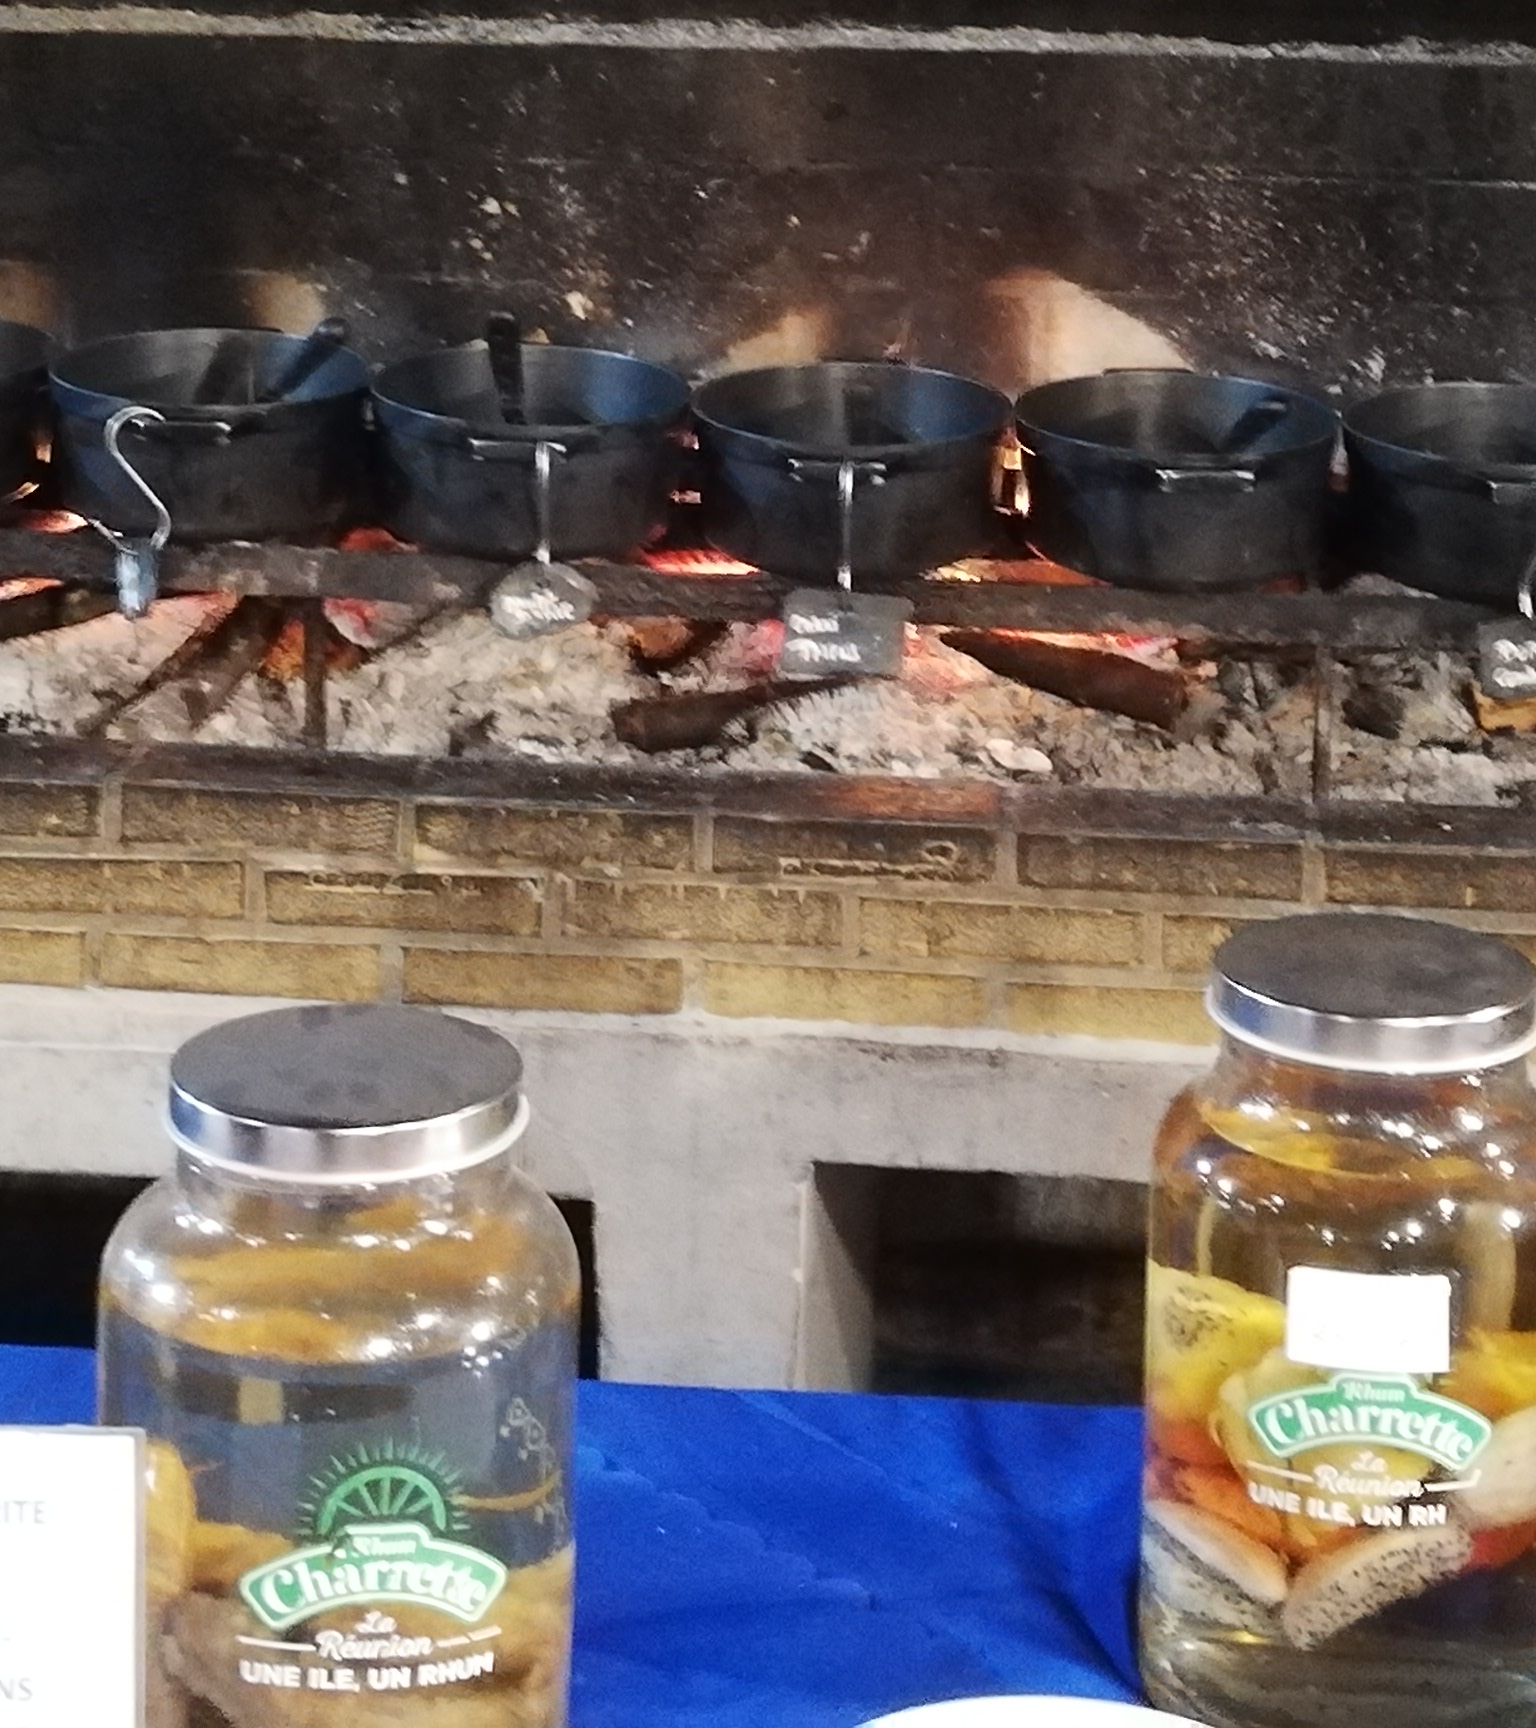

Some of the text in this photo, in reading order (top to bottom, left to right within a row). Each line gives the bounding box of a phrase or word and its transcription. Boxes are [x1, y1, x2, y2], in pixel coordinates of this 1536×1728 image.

[1265, 1397, 1474, 1462] Charrette
[1248, 1481, 1302, 1514] UNE
[1361, 1503, 1403, 1528] UN
[260, 1559, 487, 1614] Charrette
[238, 1659, 302, 1688] UNE
[366, 1668, 412, 1691] UN
